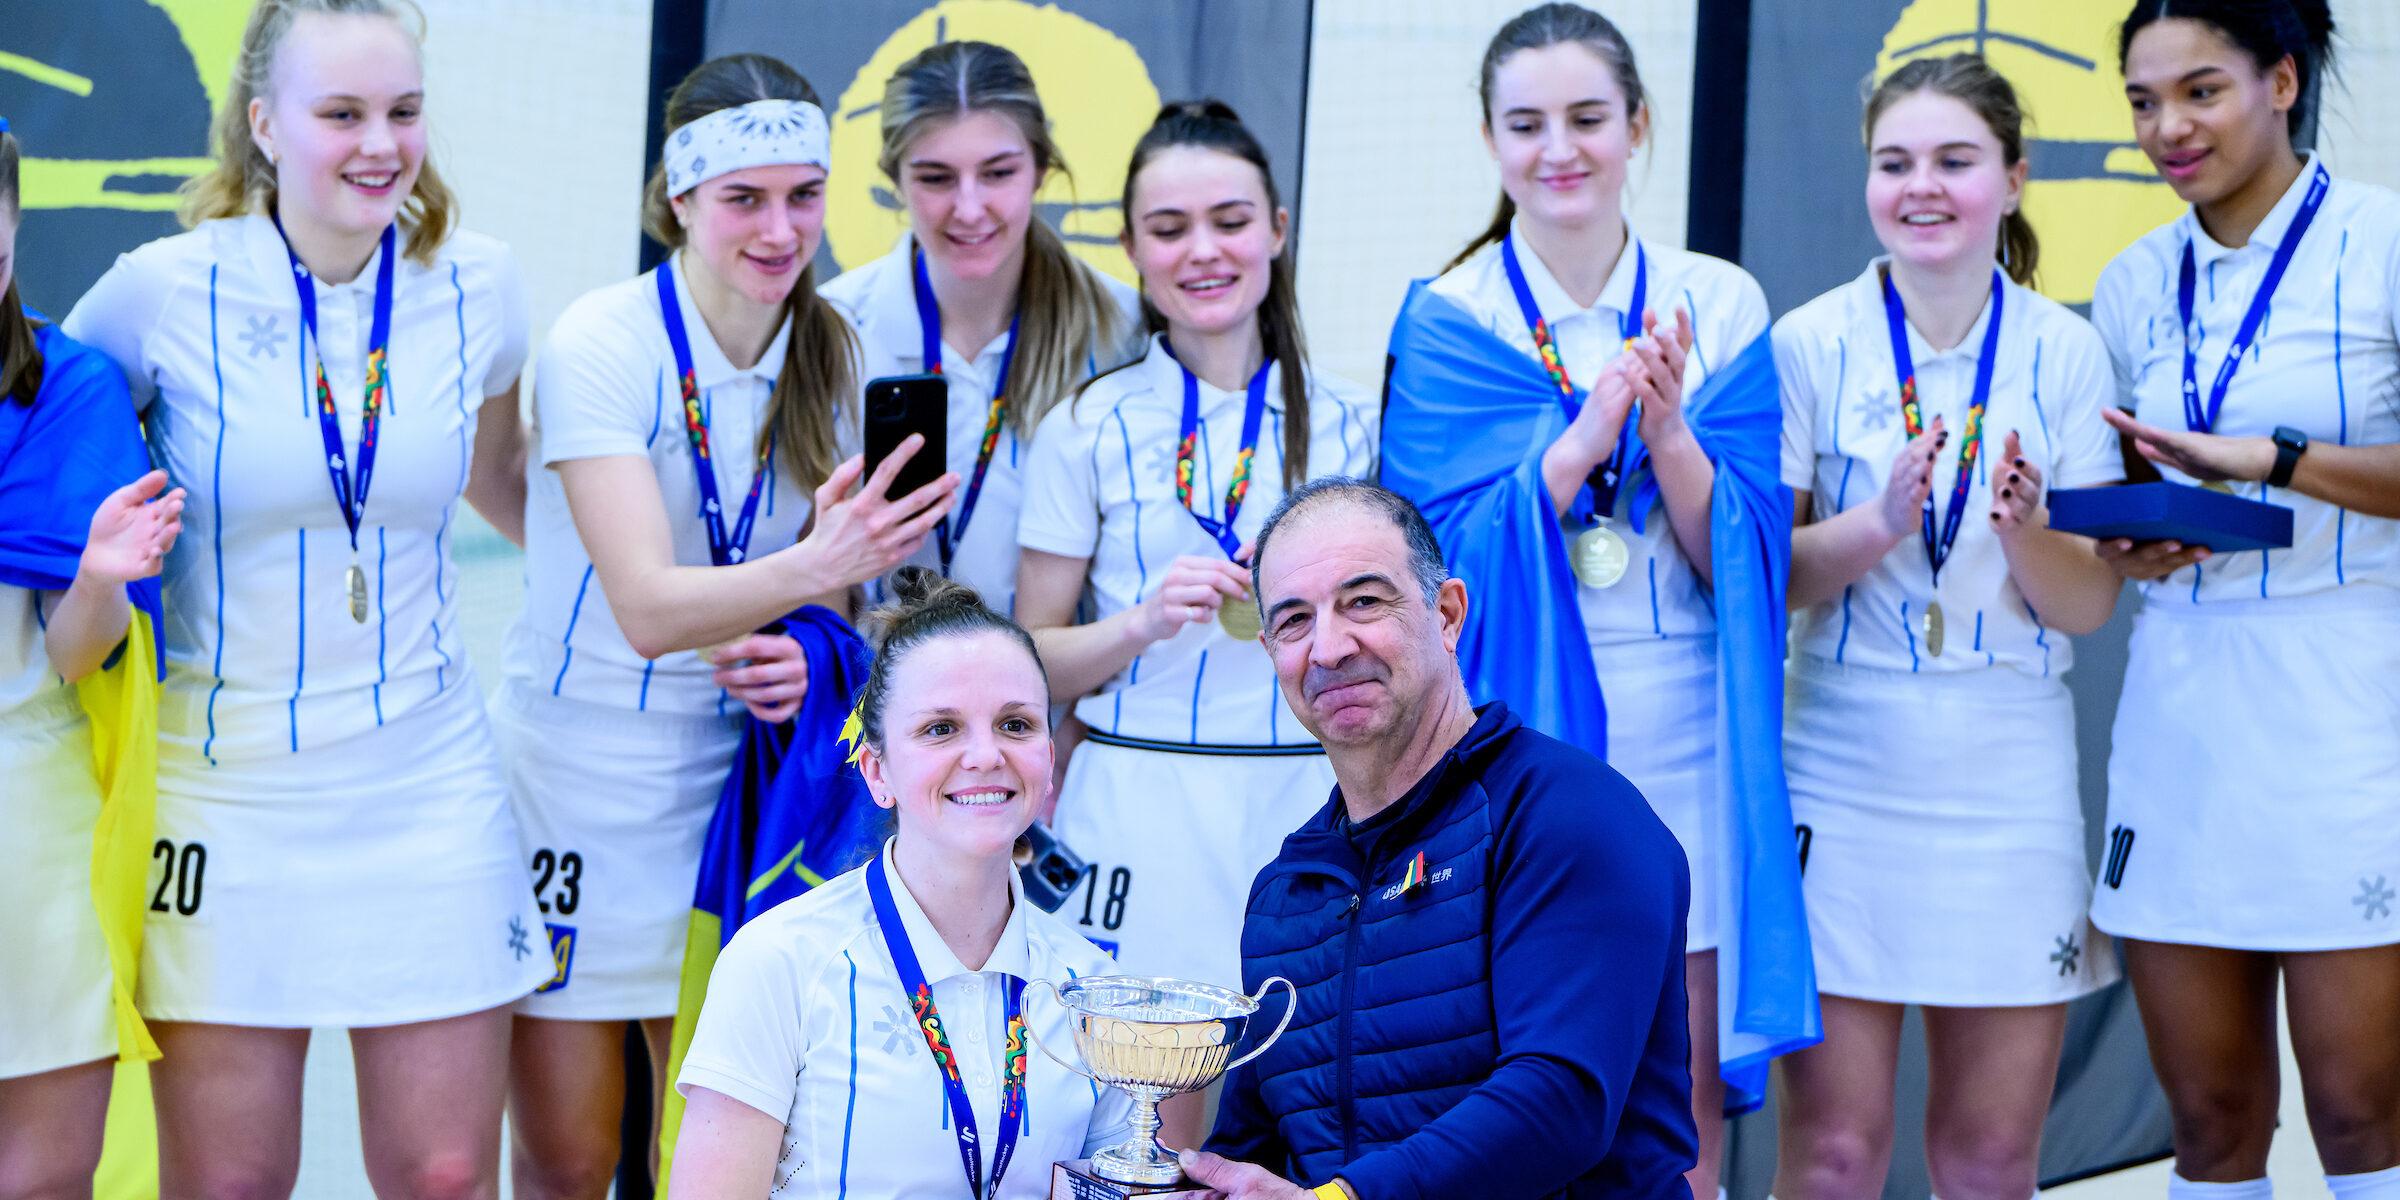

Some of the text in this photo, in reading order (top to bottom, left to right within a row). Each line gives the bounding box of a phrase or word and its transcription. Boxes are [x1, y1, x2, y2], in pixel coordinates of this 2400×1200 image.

[150, 838, 207, 916] 20
[532, 848, 584, 915] 23
[1431, 867, 1453, 885] 世界
[2103, 824, 2135, 889] 10
[1079, 863, 1131, 931] 18
